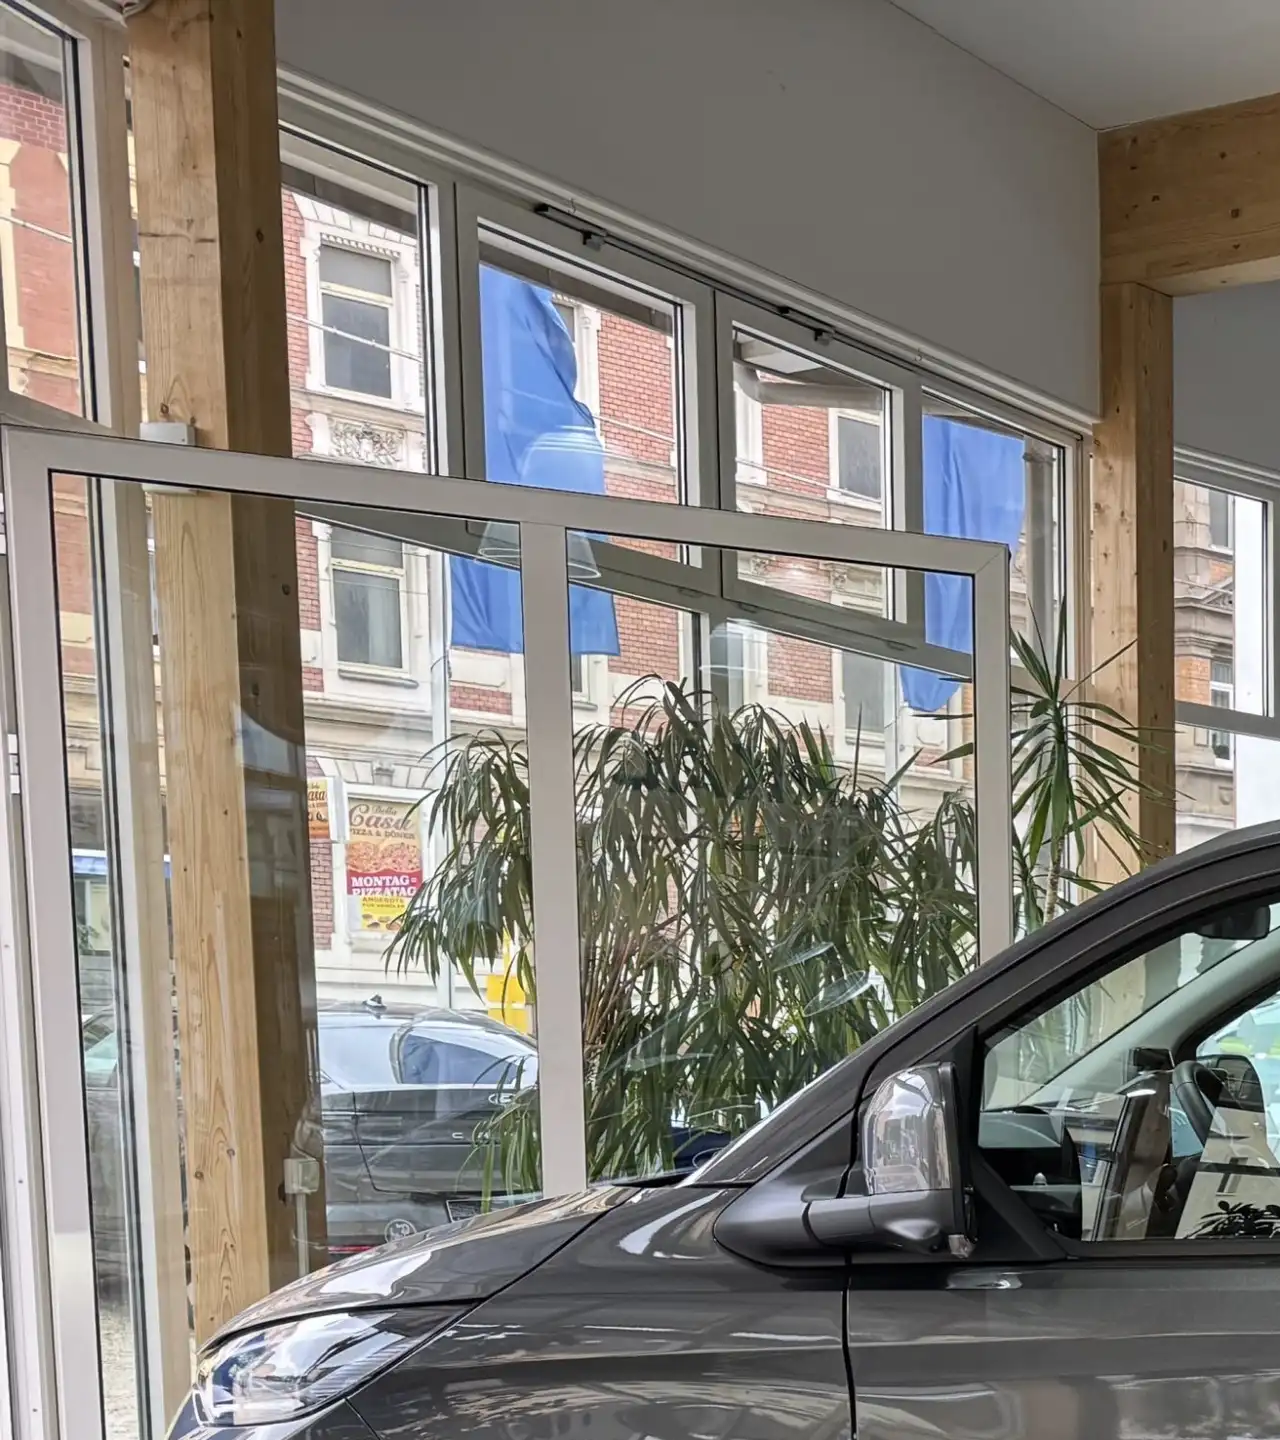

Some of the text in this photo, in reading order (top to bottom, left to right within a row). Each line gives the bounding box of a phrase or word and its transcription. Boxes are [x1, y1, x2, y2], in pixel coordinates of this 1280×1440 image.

[349, 803, 414, 831] Casa
[351, 875, 410, 888] MONTAG
[352, 886, 417, 897] PIZZATAG
